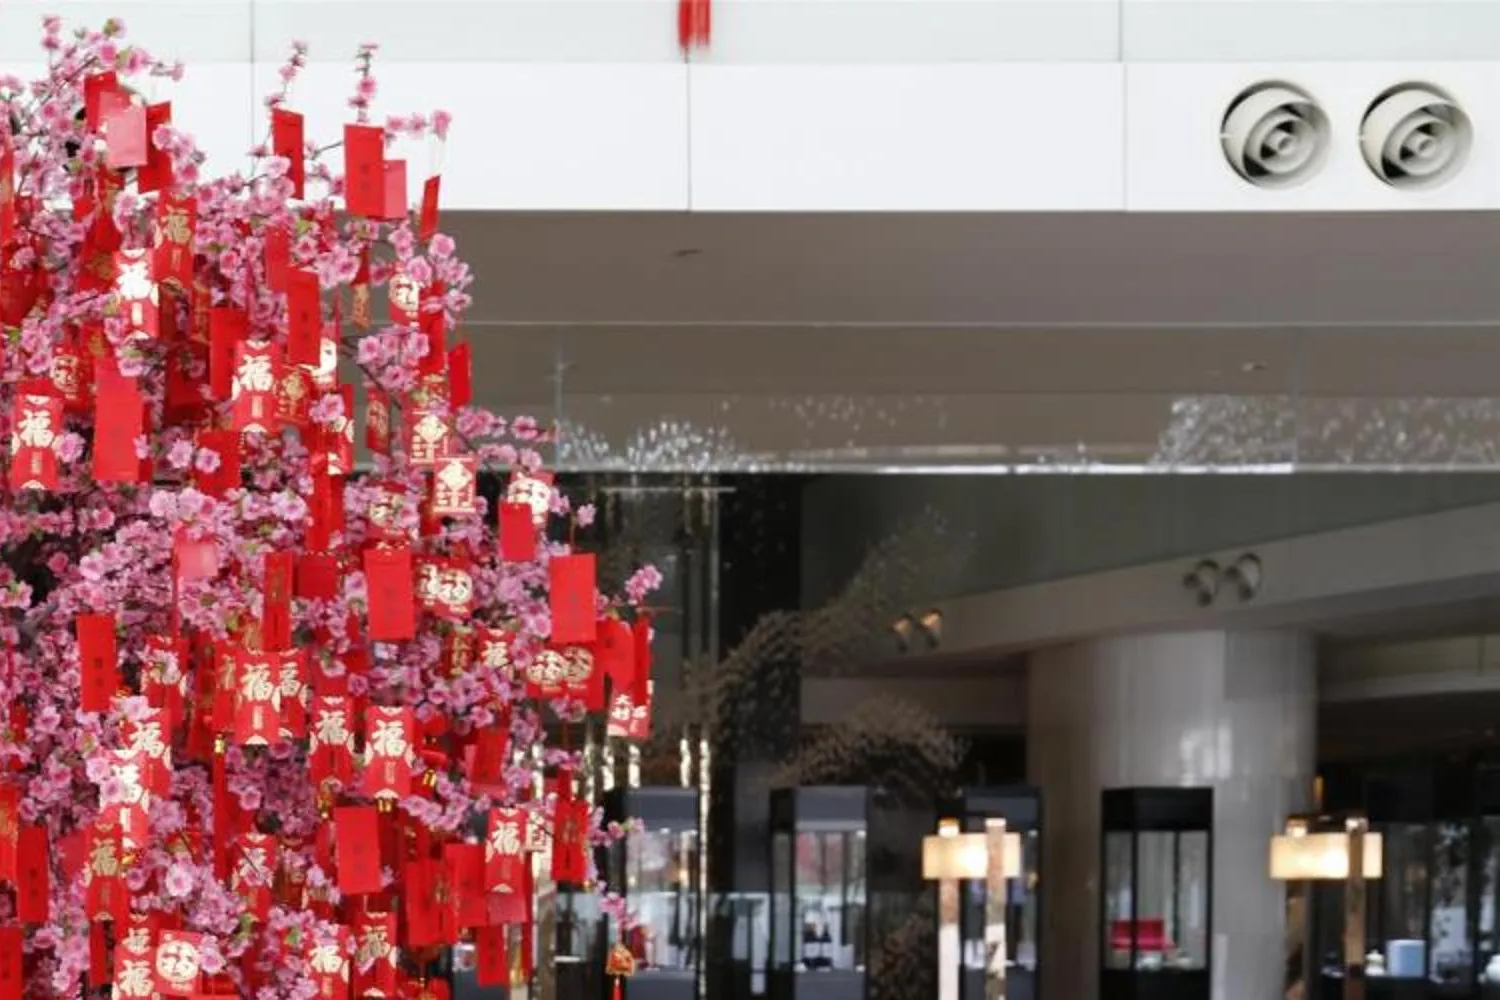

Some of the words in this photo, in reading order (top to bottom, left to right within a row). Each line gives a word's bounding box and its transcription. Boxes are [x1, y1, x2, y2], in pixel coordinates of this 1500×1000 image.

[238, 355, 273, 391] 福
[17, 410, 54, 447] 福
[240, 664, 274, 700] 福
[129, 721, 161, 759] 福
[316, 710, 349, 745] 福
[372, 719, 406, 757] 福
[491, 821, 523, 855] 福
[118, 960, 153, 997] 福
